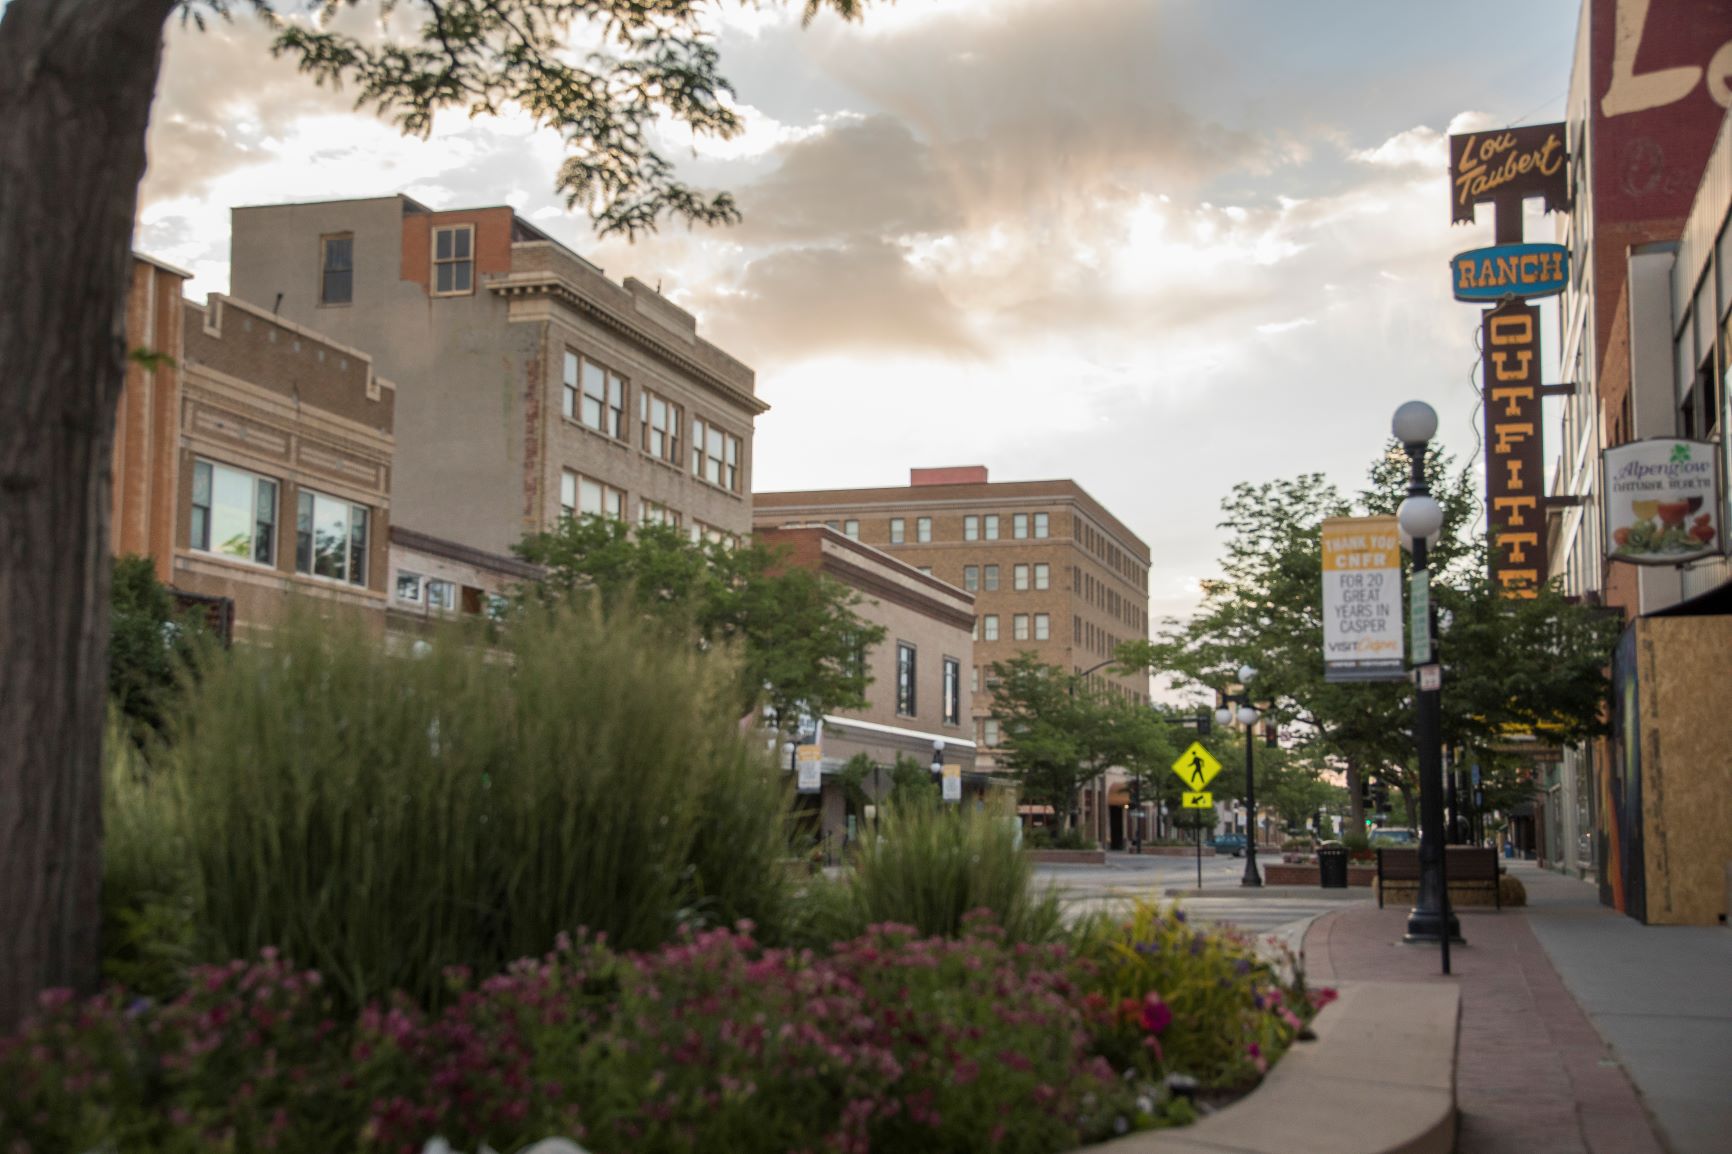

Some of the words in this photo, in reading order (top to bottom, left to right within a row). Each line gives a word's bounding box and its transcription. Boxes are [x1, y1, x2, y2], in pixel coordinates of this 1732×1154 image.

[1459, 133, 1516, 173] Lou
[1456, 134, 1562, 205] Taubert
[1458, 252, 1563, 289] RANCH
[1490, 314, 1538, 600] OUTFITTE
[1327, 537, 1365, 551] THANK
[1372, 536, 1394, 549] YOU
[1336, 554, 1385, 567] CNFR
[1340, 573, 1363, 588] FOR
[1367, 573, 1383, 587] 20
[1344, 589, 1379, 602] GREAT
[1335, 604, 1372, 618] YEARS
[1376, 603, 1389, 617] IN
[1341, 620, 1385, 633] CASPER
